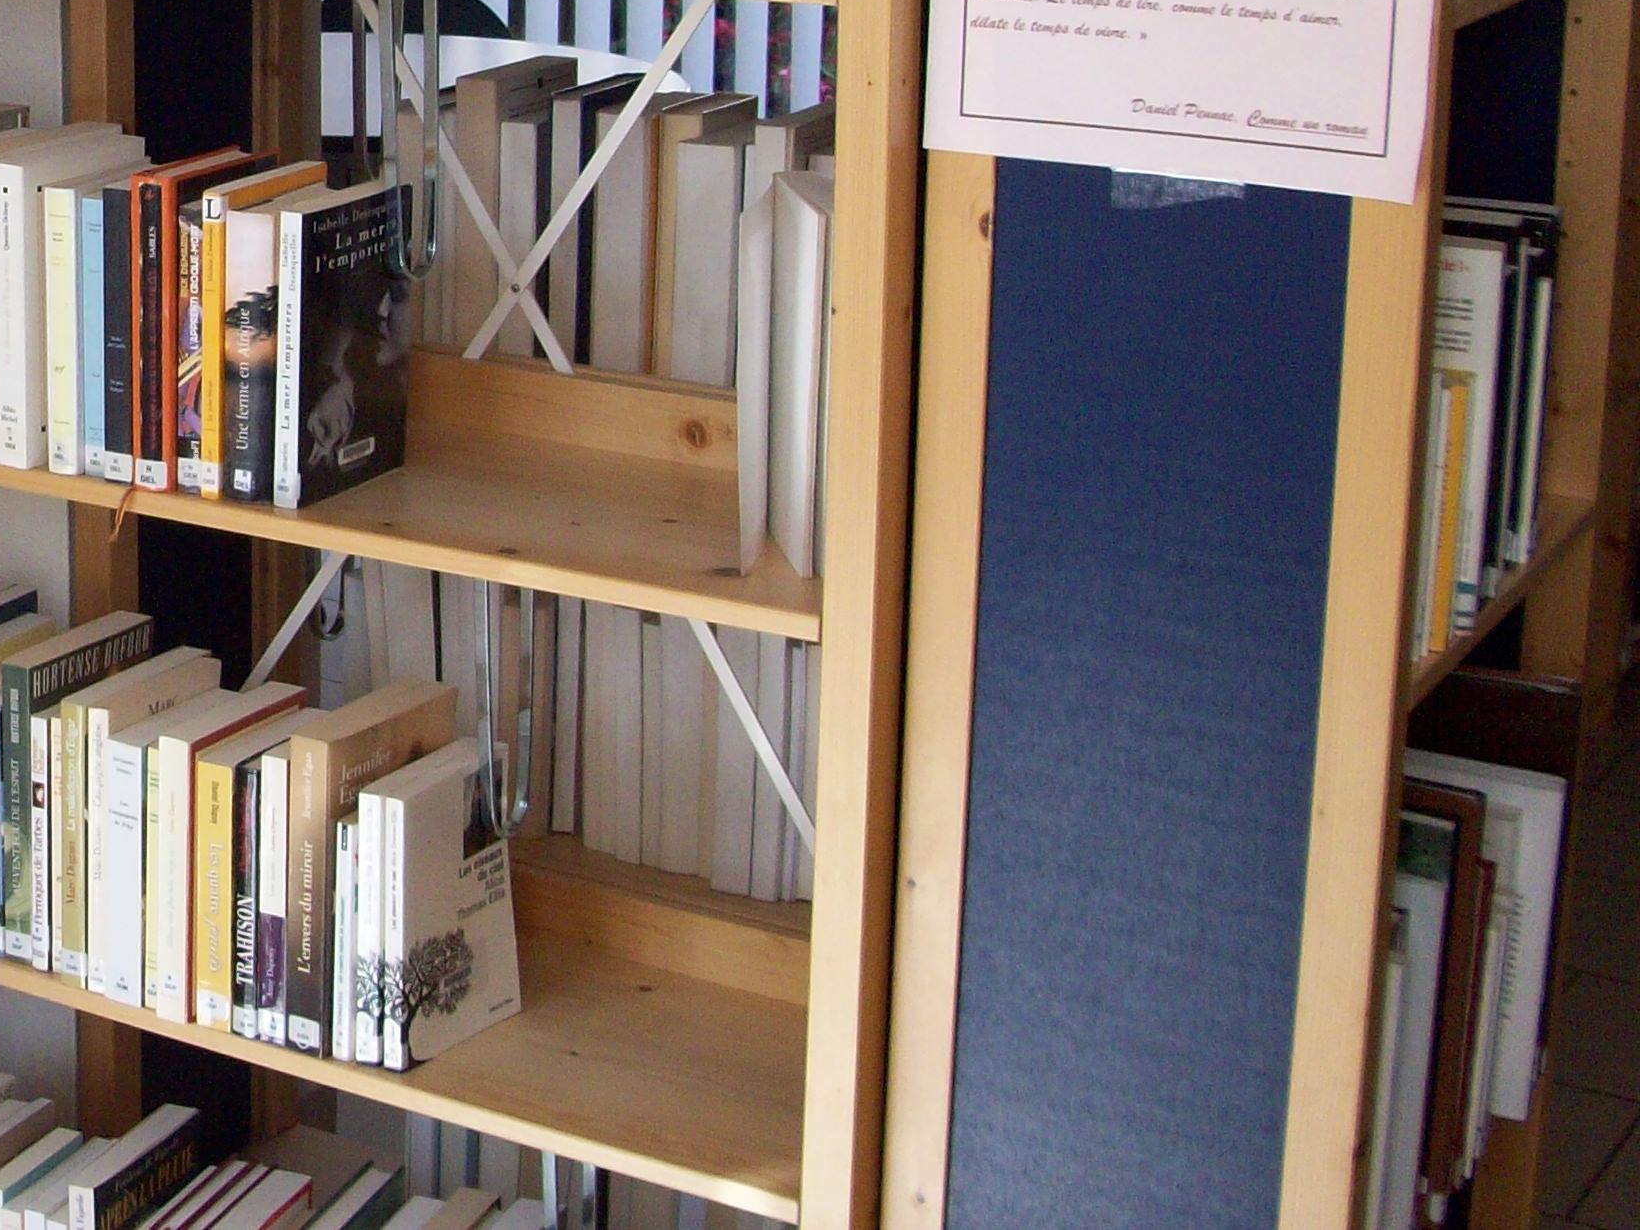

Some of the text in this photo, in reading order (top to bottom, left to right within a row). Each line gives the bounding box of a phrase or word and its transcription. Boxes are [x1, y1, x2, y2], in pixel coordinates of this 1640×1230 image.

[1012, 16, 1026, 31] le
[1029, 20, 1069, 36] temps
[1072, 21, 1091, 36] de
[1170, 3, 1216, 15] comme
[1219, 2, 1234, 17] le
[1237, 5, 1277, 22] temps
[1130, 97, 1180, 116] Daniel
[1245, 108, 1297, 129] Comme
[1300, 120, 1320, 130] un
[1323, 122, 1368, 135] roman
[33, 647, 100, 698] HORTENSE
[296, 840, 313, 974] L'envers du miroir
[235, 893, 254, 986] TRAHISON
